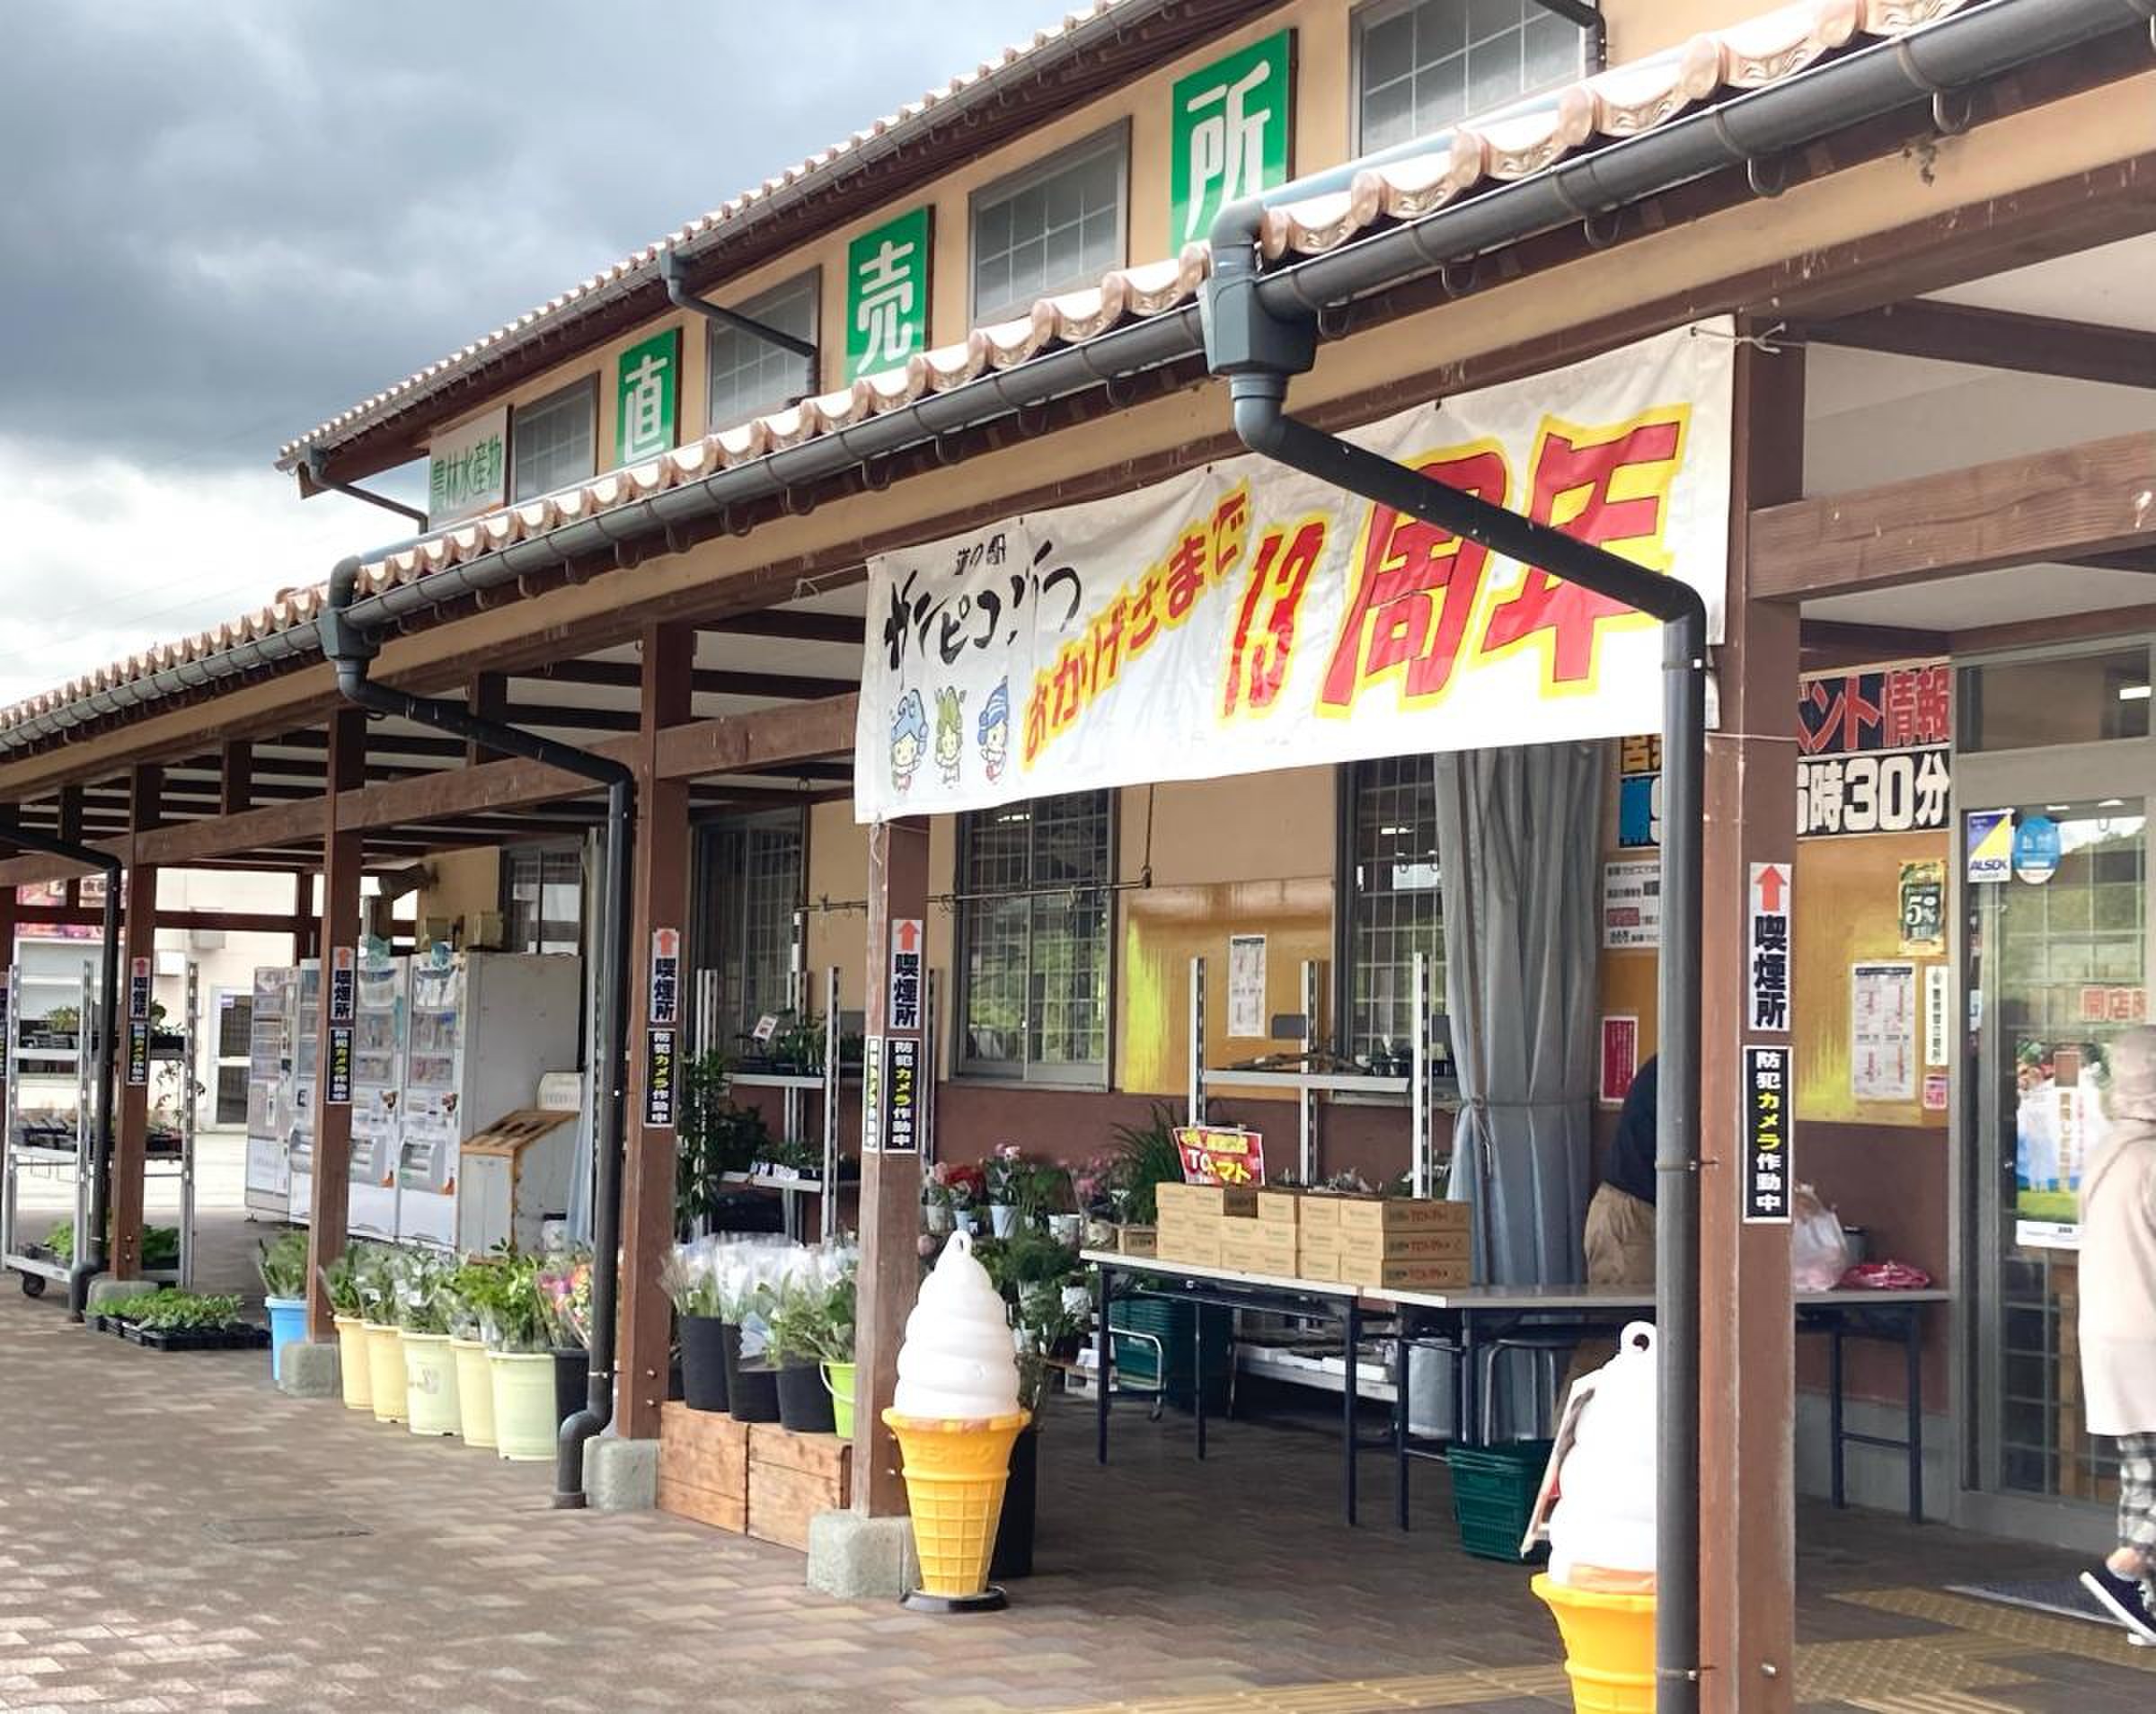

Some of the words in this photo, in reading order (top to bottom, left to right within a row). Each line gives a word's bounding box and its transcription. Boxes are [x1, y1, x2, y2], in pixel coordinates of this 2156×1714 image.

[625, 355, 667, 464] 直
[857, 240, 915, 375] 売
[1184, 59, 1271, 241] 所
[954, 534, 1006, 575] 道の駅
[1025, 490, 1247, 763] おかげさまで
[654, 958, 676, 1021] 喫煙所
[894, 953, 919, 1028] 喫煙所
[1754, 914, 1788, 1029] 喫煙所
[892, 1041, 912, 1146] 防犯カメラ作動中
[1755, 1053, 1781, 1212] 防犯カメラ作動中
